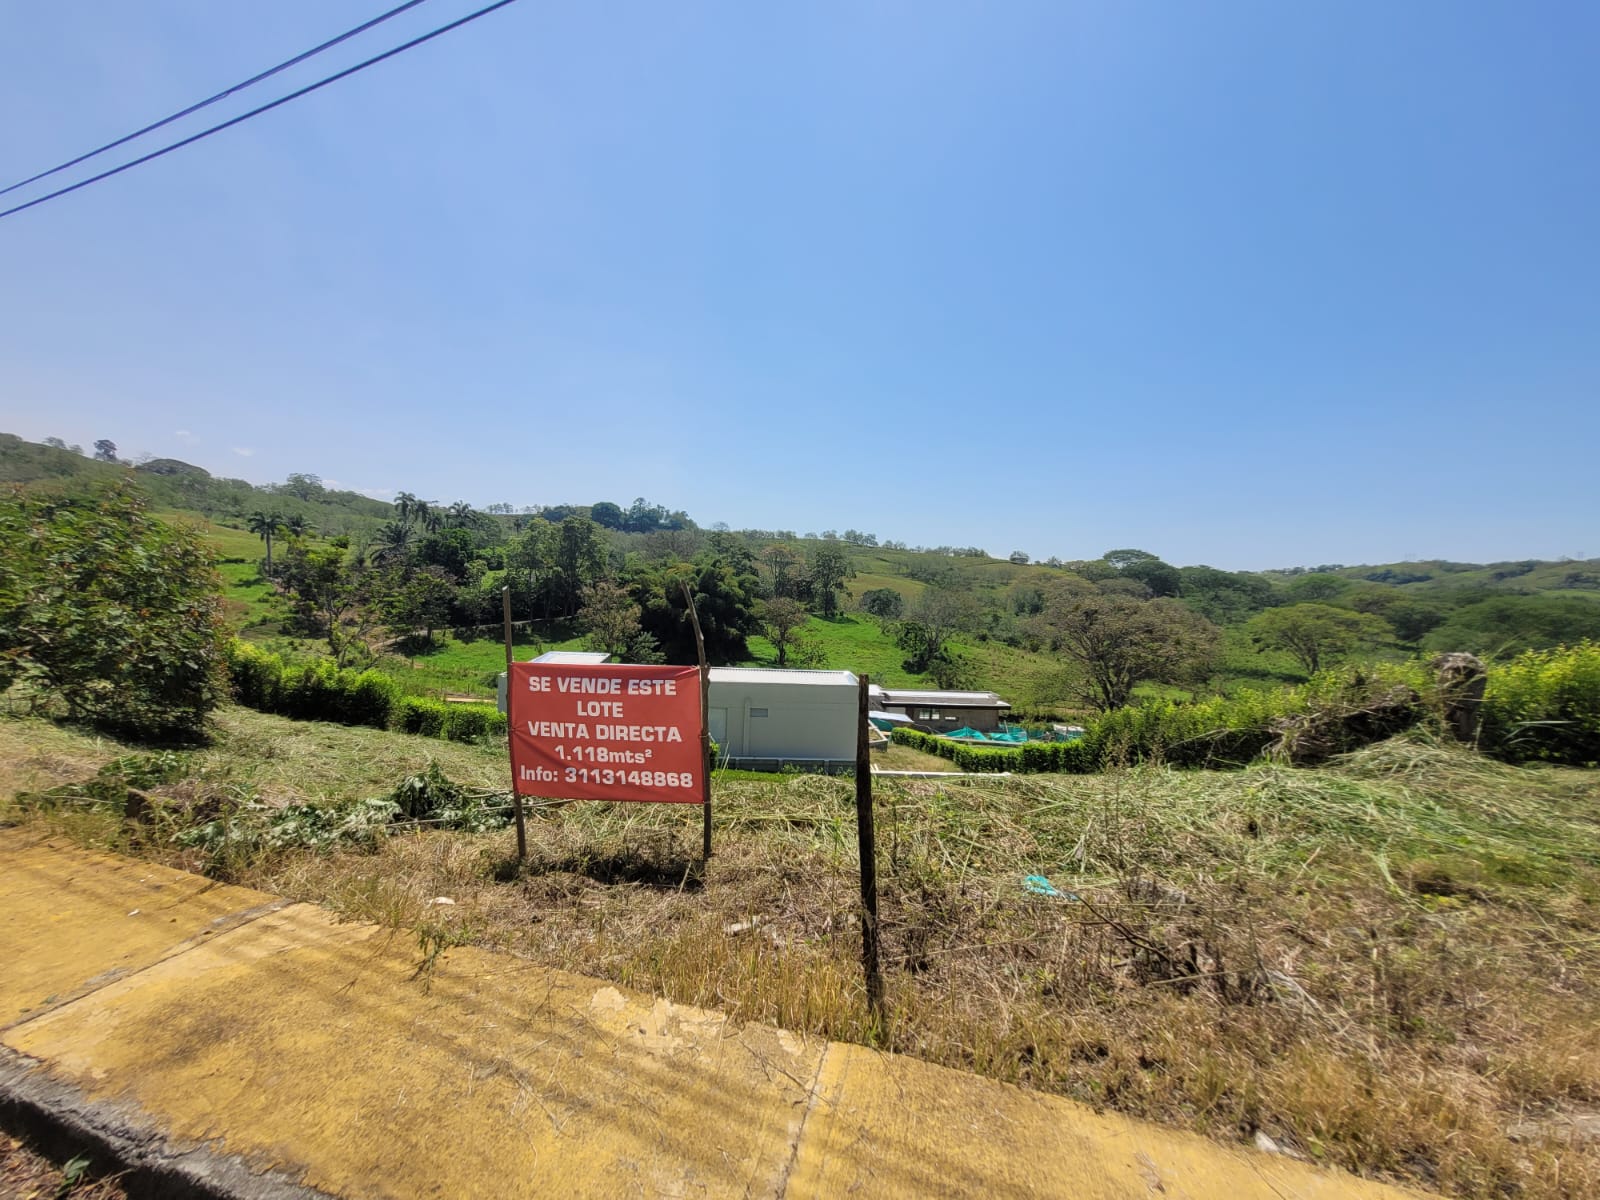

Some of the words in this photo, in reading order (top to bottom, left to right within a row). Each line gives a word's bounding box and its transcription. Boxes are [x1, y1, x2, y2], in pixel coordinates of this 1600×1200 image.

[529, 676, 552, 692] SE
[557, 677, 622, 695] VENDE
[627, 679, 677, 696] ESTE
[577, 700, 624, 718] LOTE
[528, 721, 590, 739] VENTA
[595, 724, 682, 743] DIRECTA
[520, 765, 558, 782] Info:
[564, 767, 693, 788] 3113148868
